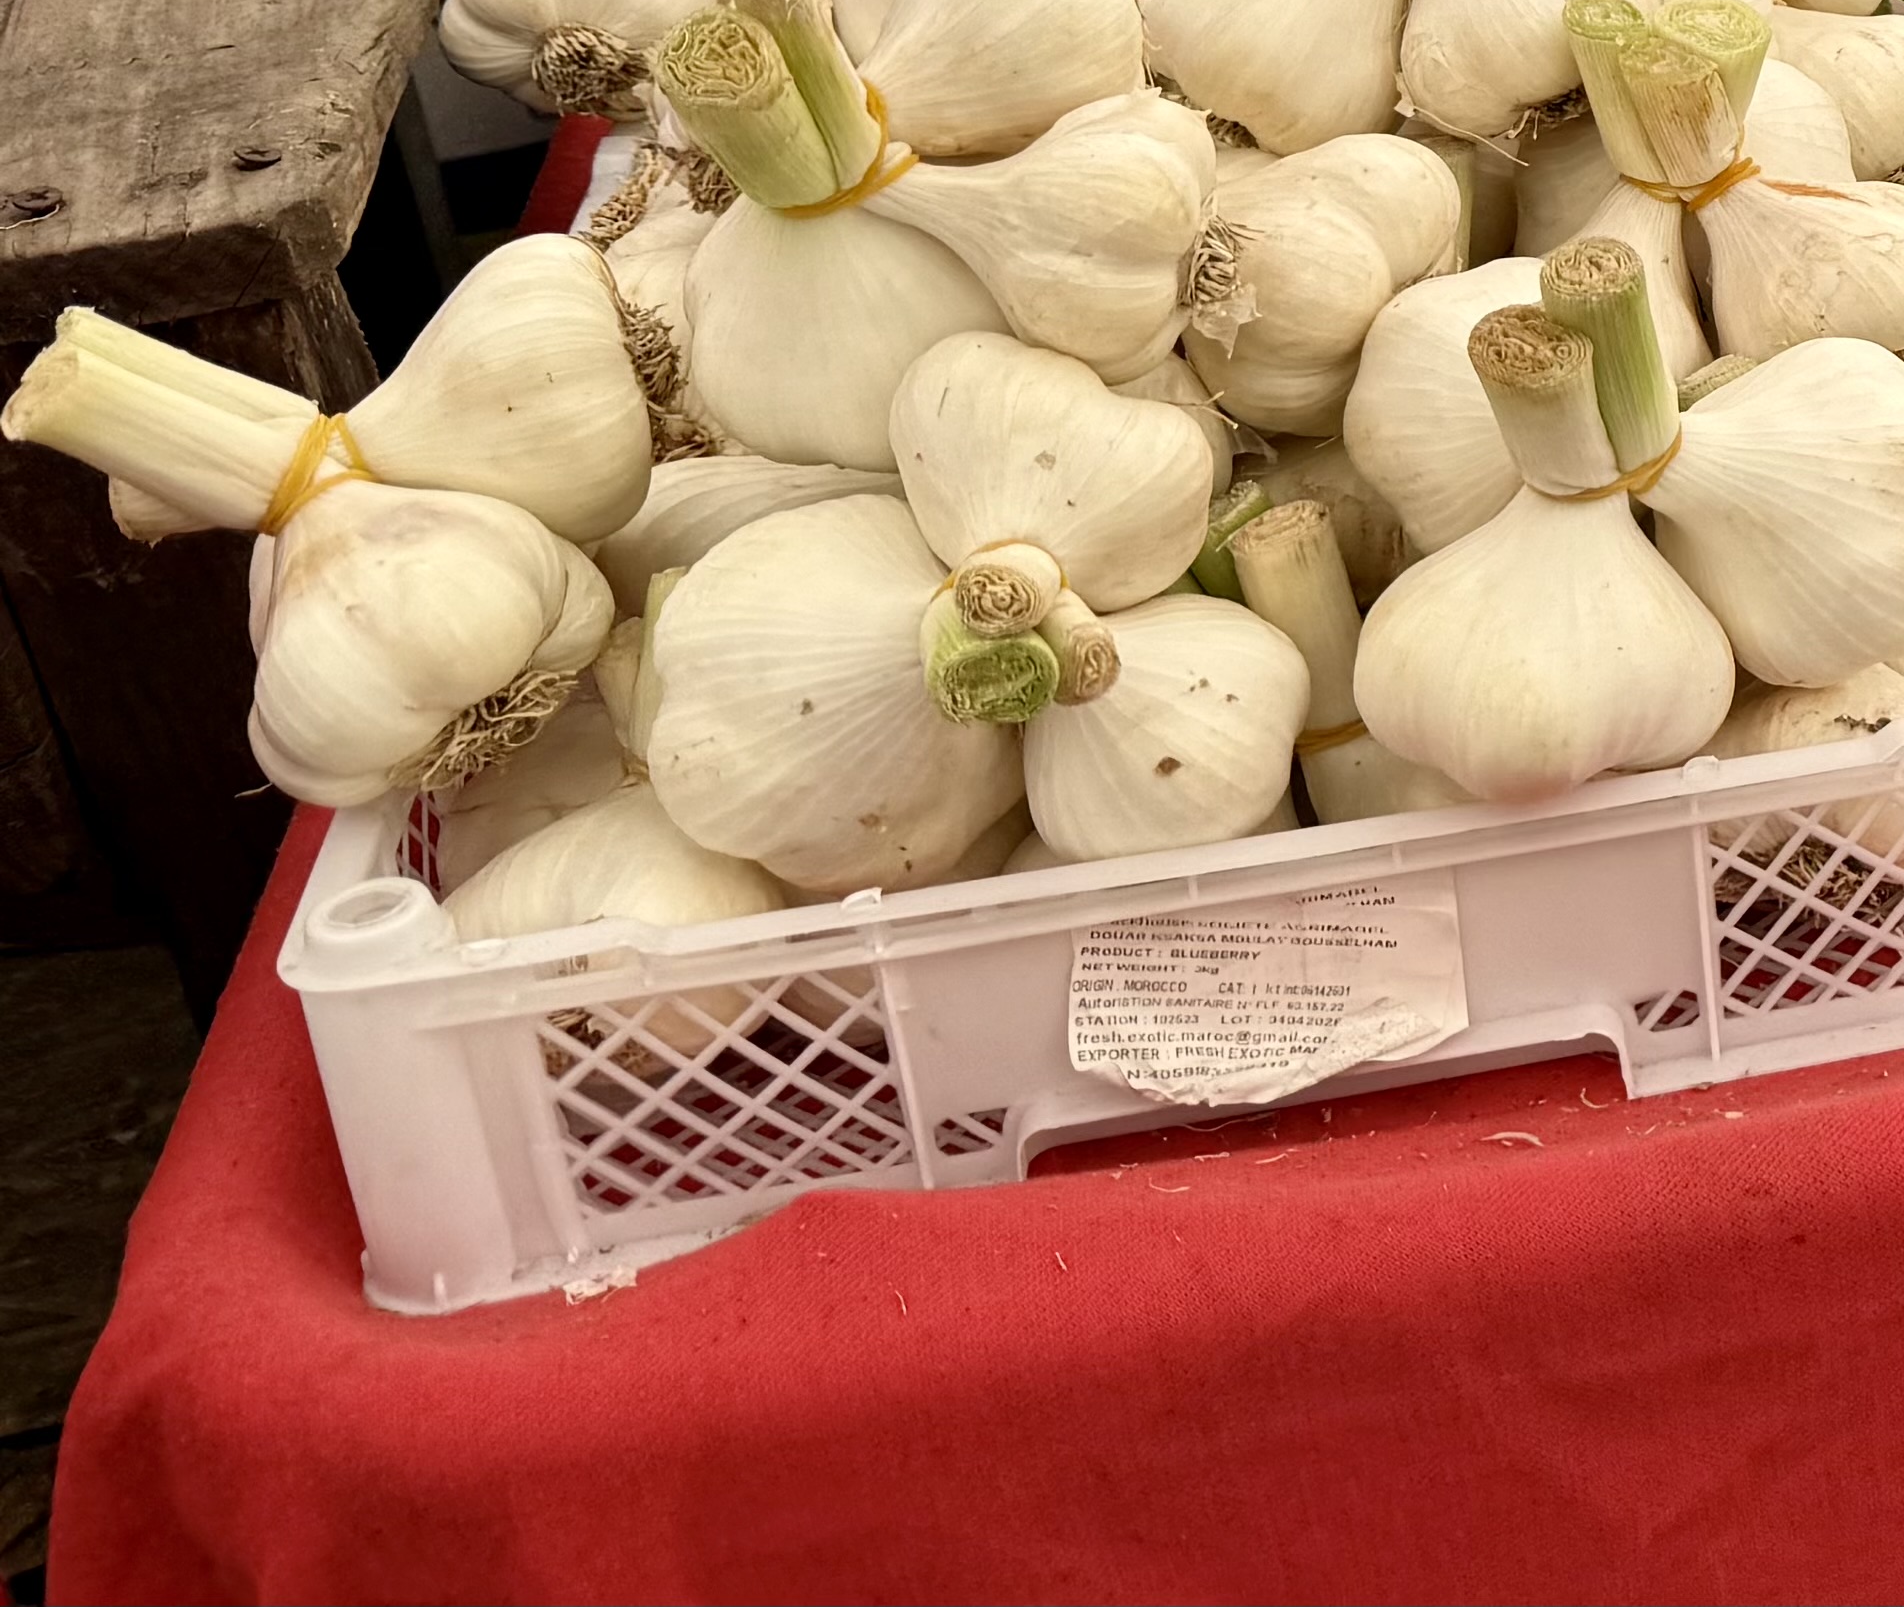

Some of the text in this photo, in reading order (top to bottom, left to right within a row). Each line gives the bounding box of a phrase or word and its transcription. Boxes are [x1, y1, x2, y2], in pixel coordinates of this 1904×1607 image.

[1080, 946, 1261, 961] PRODUCT BLUEBERRY
[1123, 979, 1188, 993] MOROCCO
[1165, 998, 1234, 1010] SANITAIRE
[1077, 1047, 1160, 1062] EXPORTER
